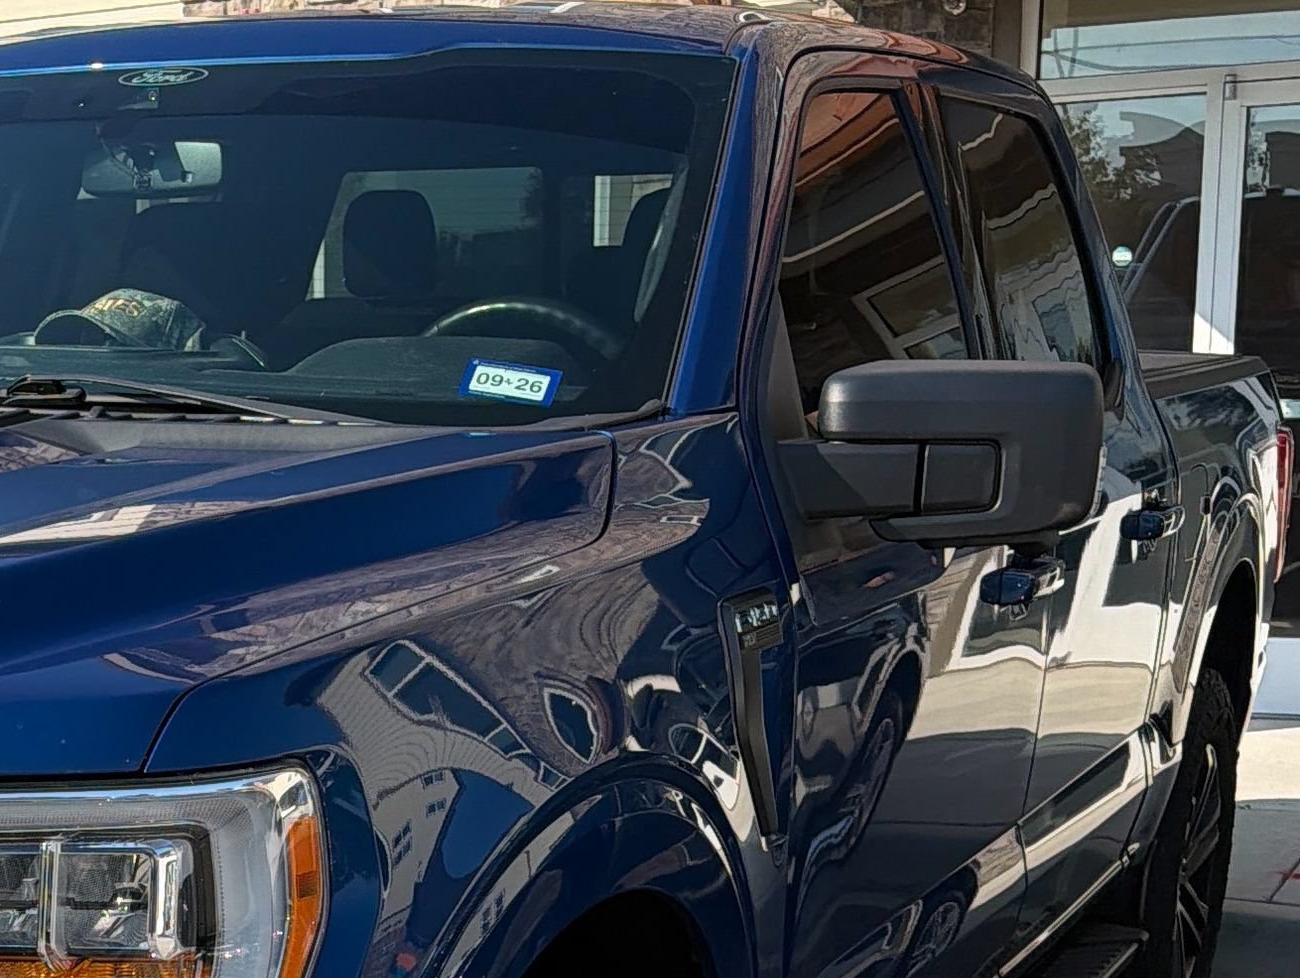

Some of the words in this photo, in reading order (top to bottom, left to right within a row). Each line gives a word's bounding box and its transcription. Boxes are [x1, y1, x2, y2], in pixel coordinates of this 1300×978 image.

[132, 69, 195, 83] Ford
[476, 372, 504, 387] 09
[514, 378, 544, 393] 26
